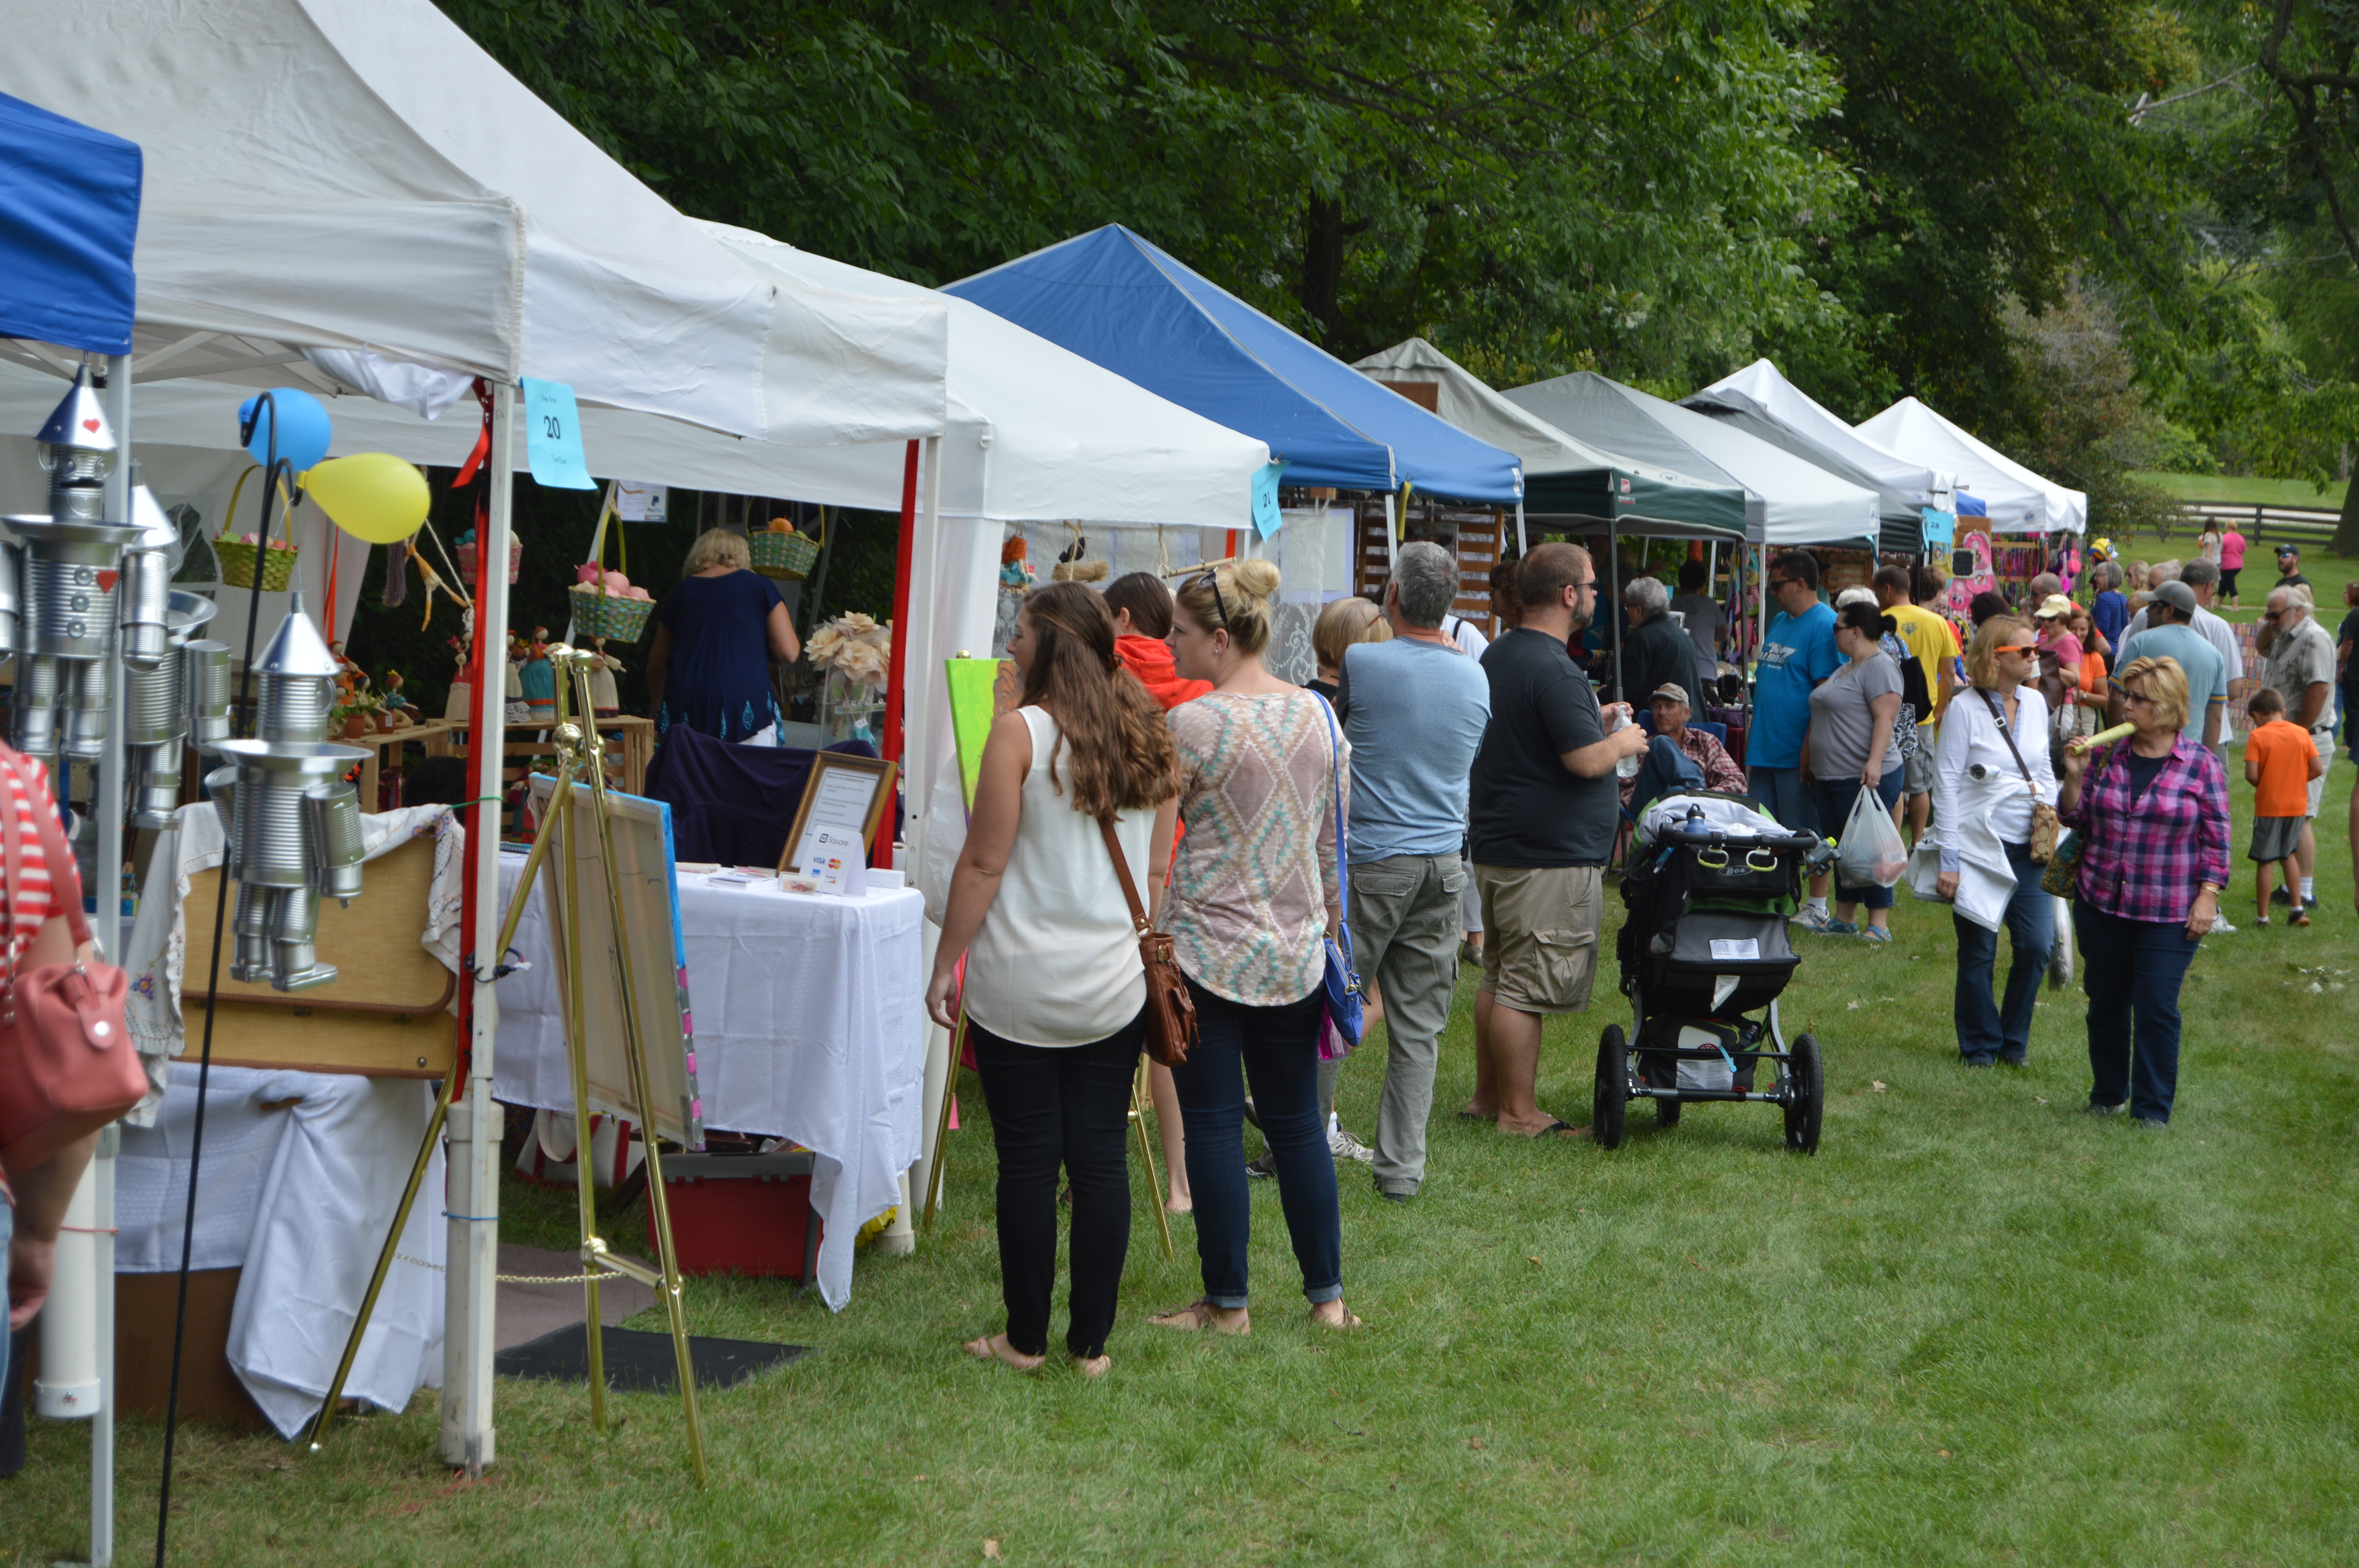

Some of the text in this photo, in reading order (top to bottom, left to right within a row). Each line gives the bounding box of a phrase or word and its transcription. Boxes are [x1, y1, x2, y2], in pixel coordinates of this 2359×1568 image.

[543, 415, 560, 439] 20
[1263, 490, 1271, 508] 21
[828, 836, 849, 846] Square
[813, 856, 825, 864] VISA
